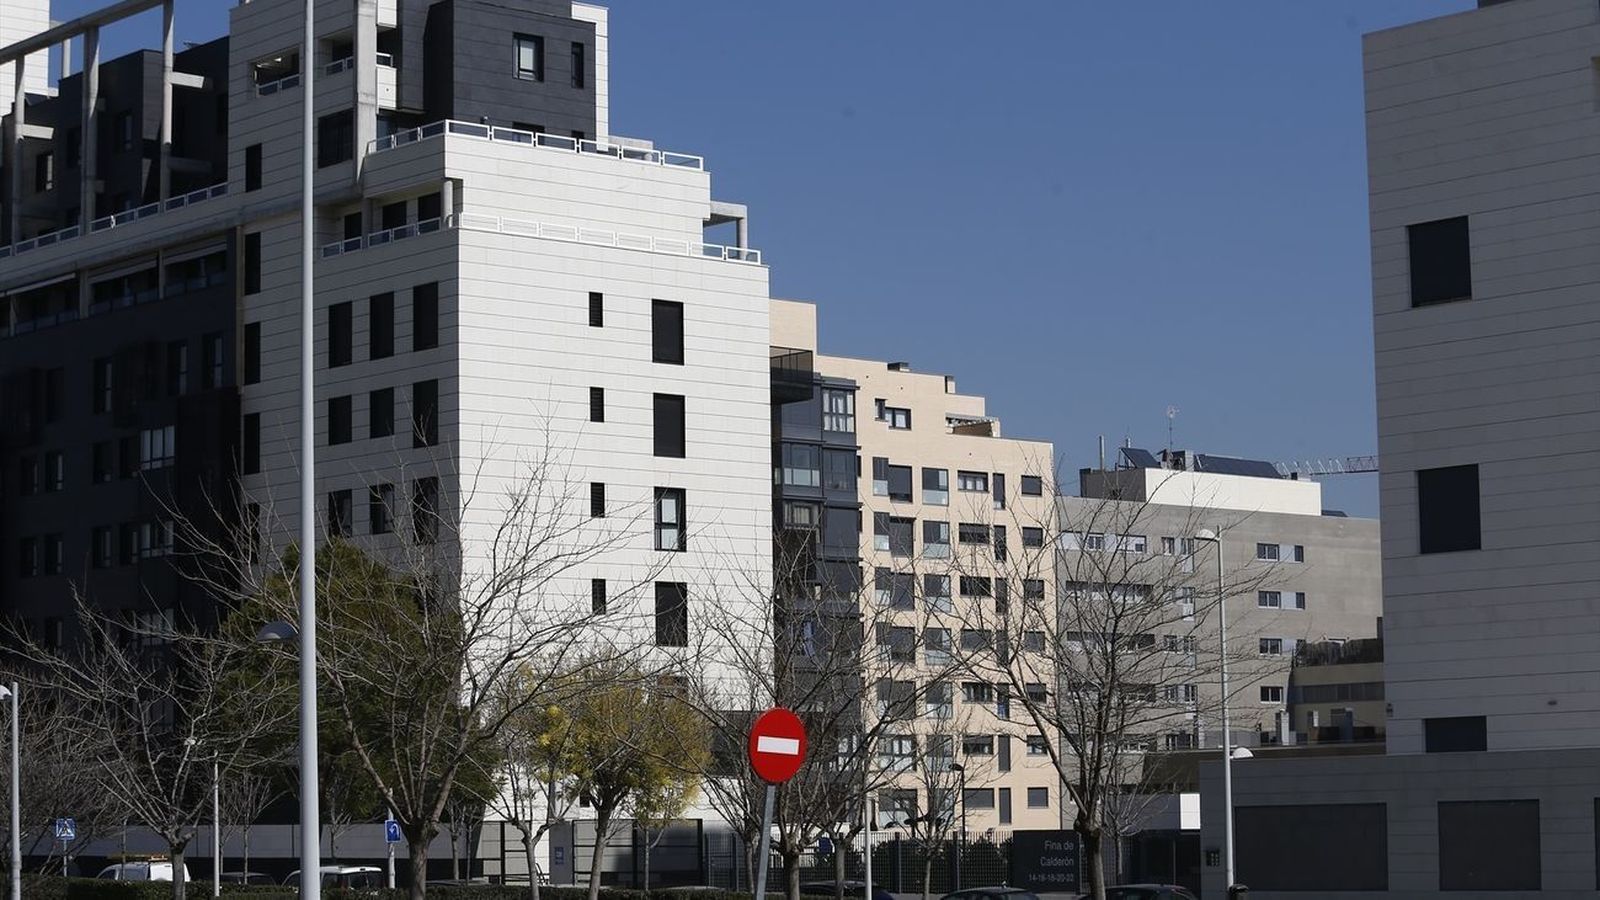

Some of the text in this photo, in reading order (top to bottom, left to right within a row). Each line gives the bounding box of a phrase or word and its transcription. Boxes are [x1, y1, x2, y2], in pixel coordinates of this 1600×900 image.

[1044, 840, 1074, 850] Fina de
[1040, 855, 1074, 866] Calderón
